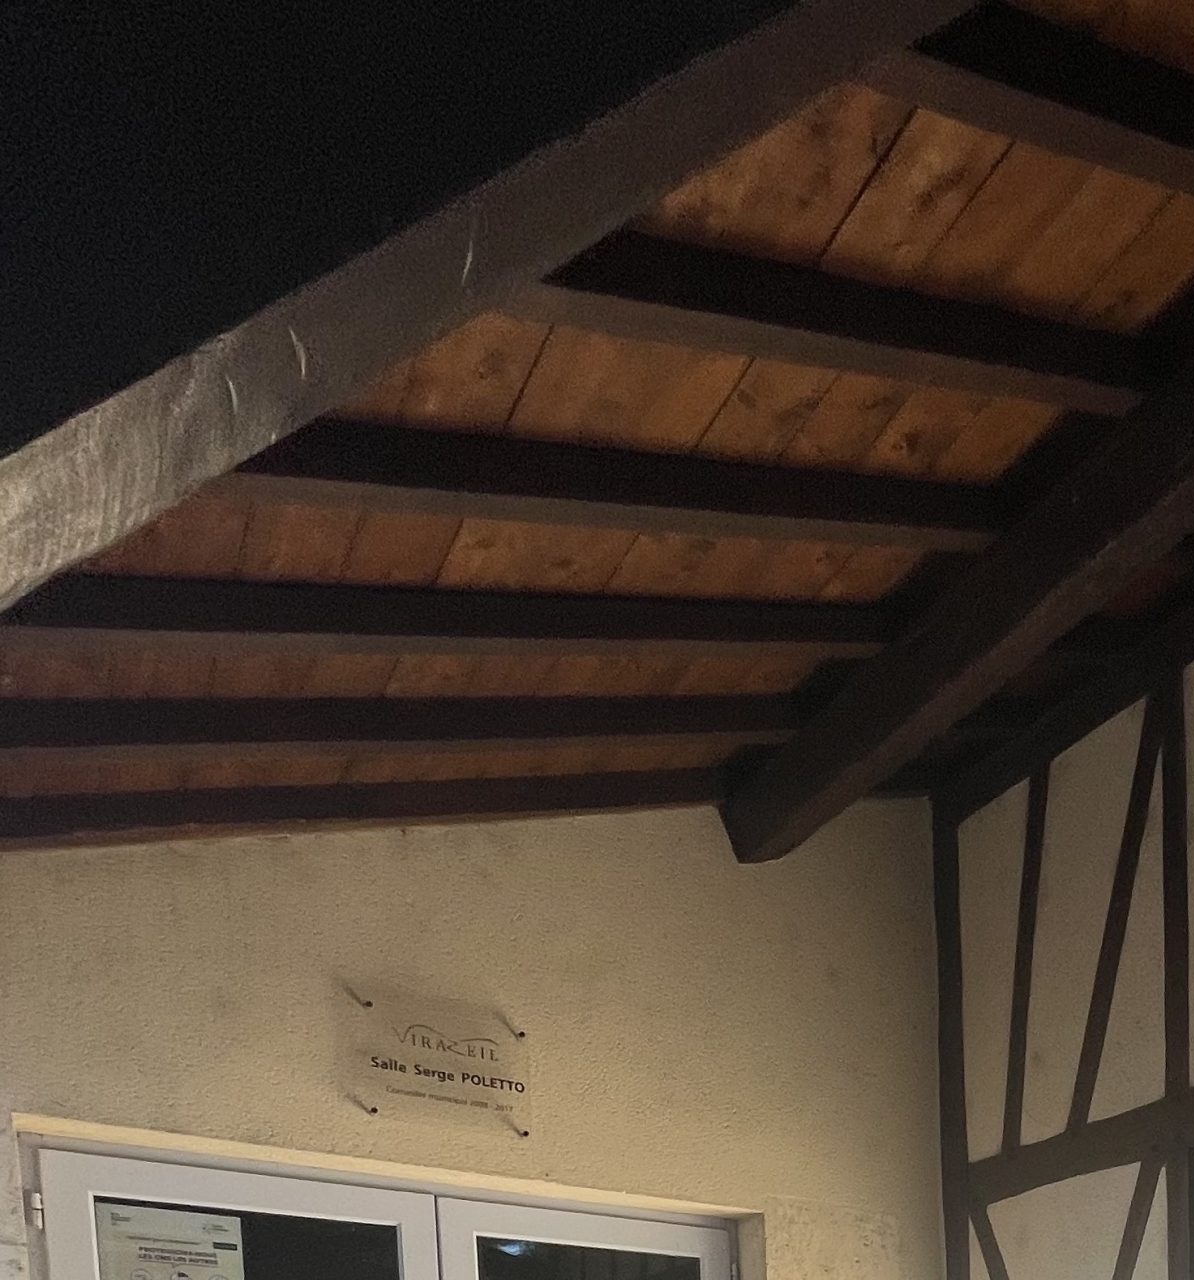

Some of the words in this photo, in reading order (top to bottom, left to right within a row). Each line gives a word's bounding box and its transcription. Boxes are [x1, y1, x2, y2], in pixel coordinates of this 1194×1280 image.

[392, 1024, 499, 1061] VIRAZEIL
[370, 1055, 407, 1074] Salle
[413, 1063, 455, 1083] Serge
[461, 1071, 525, 1093] POLETTO
